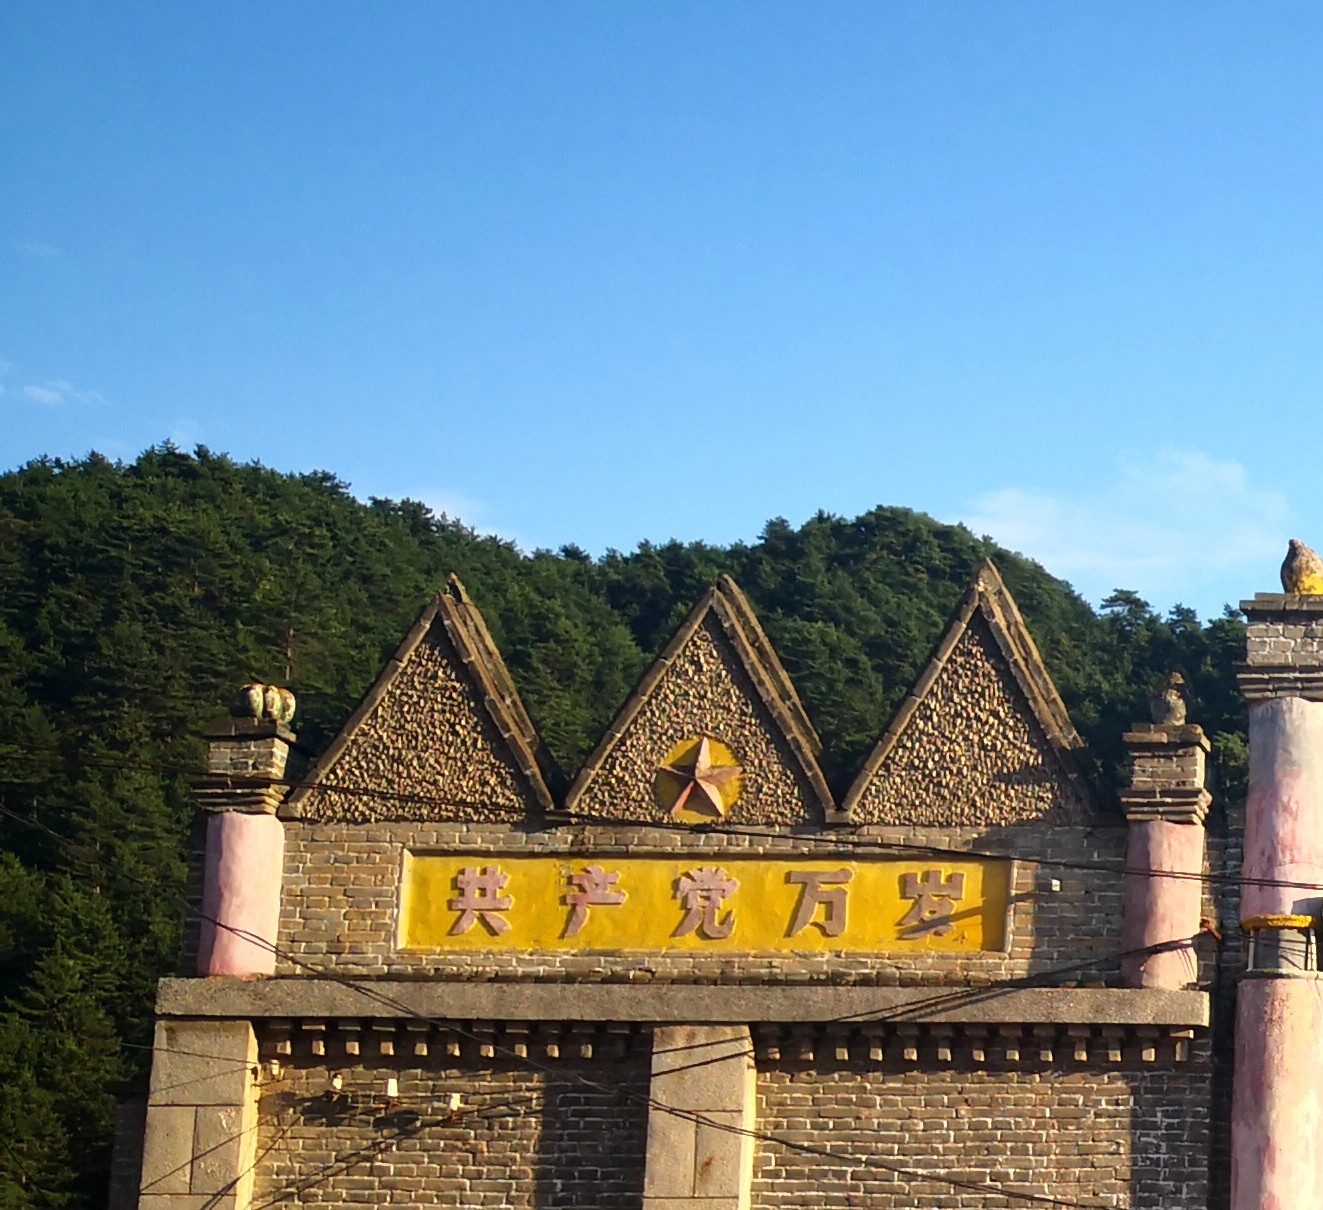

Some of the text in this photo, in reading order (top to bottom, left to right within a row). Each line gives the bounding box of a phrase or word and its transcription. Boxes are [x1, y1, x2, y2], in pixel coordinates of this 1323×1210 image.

[450, 865, 964, 940] 共产党万岁
